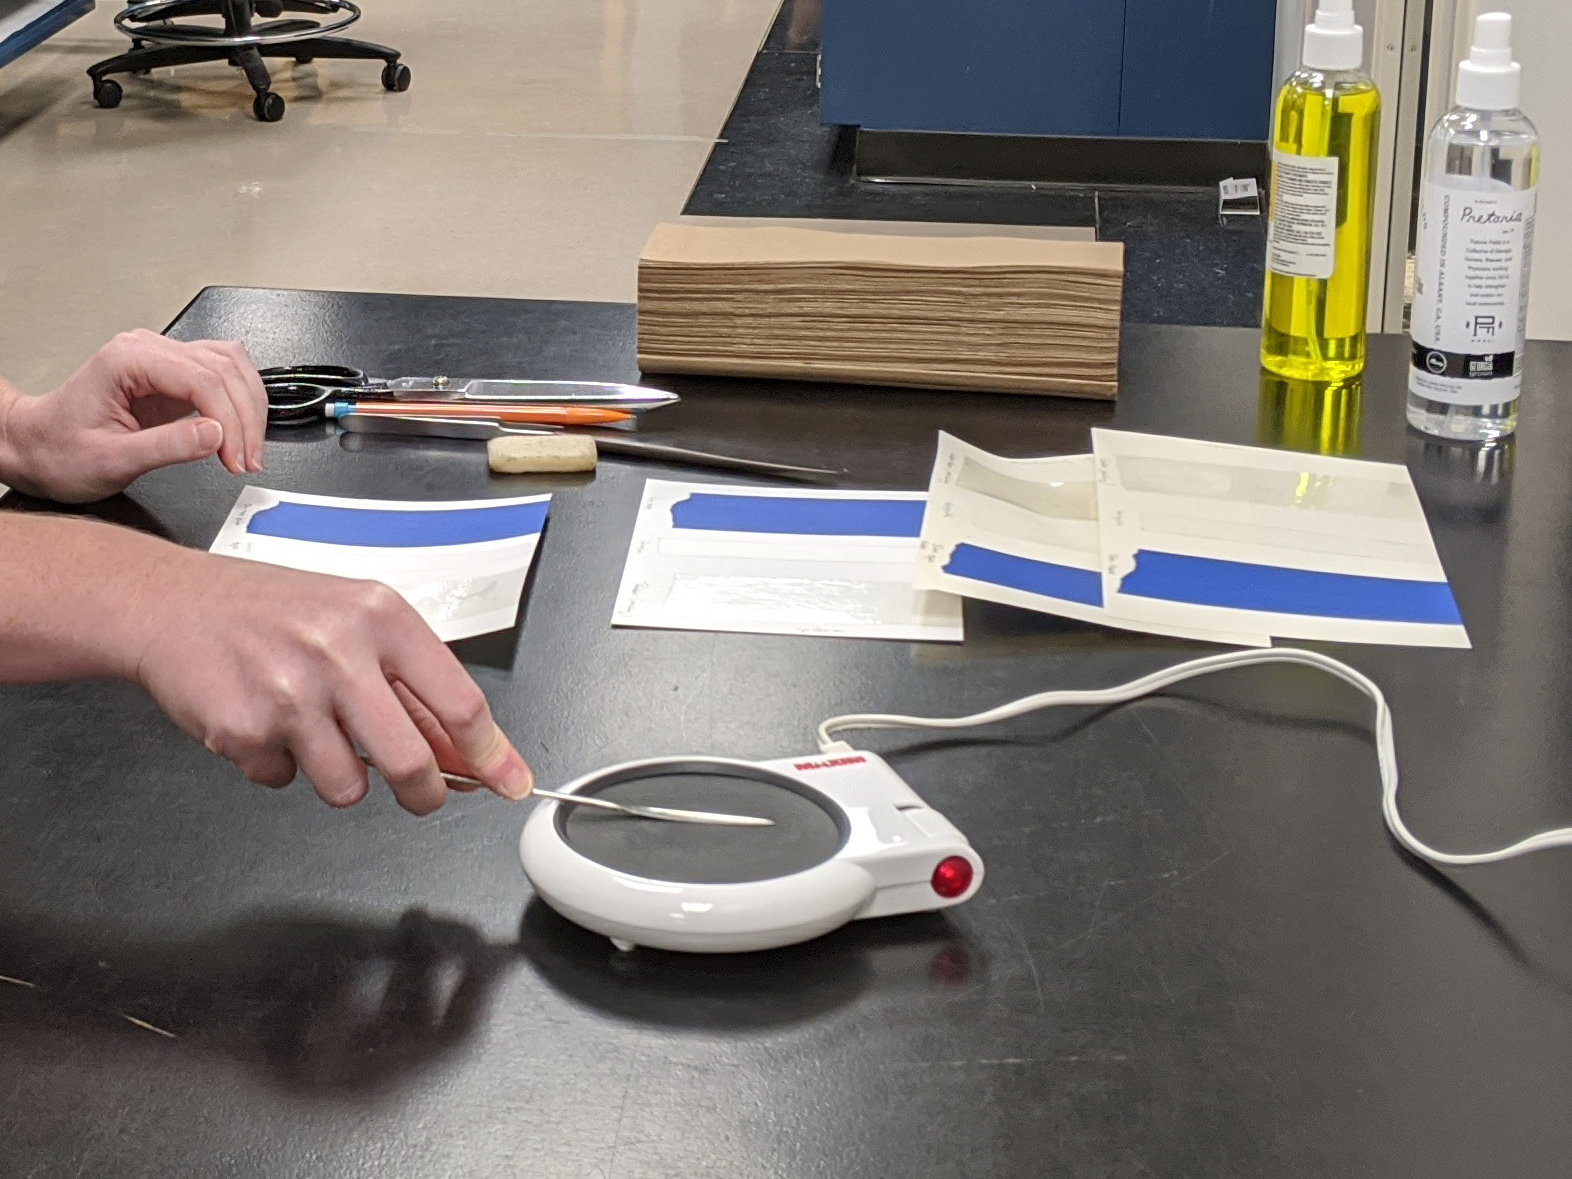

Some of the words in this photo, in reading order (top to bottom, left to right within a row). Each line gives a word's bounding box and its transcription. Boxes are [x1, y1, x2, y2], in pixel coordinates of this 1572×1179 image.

[1460, 206, 1523, 224] Pretoria
[1440, 194, 1450, 256] COMPOUNDED
[1439, 258, 1446, 268] IN
